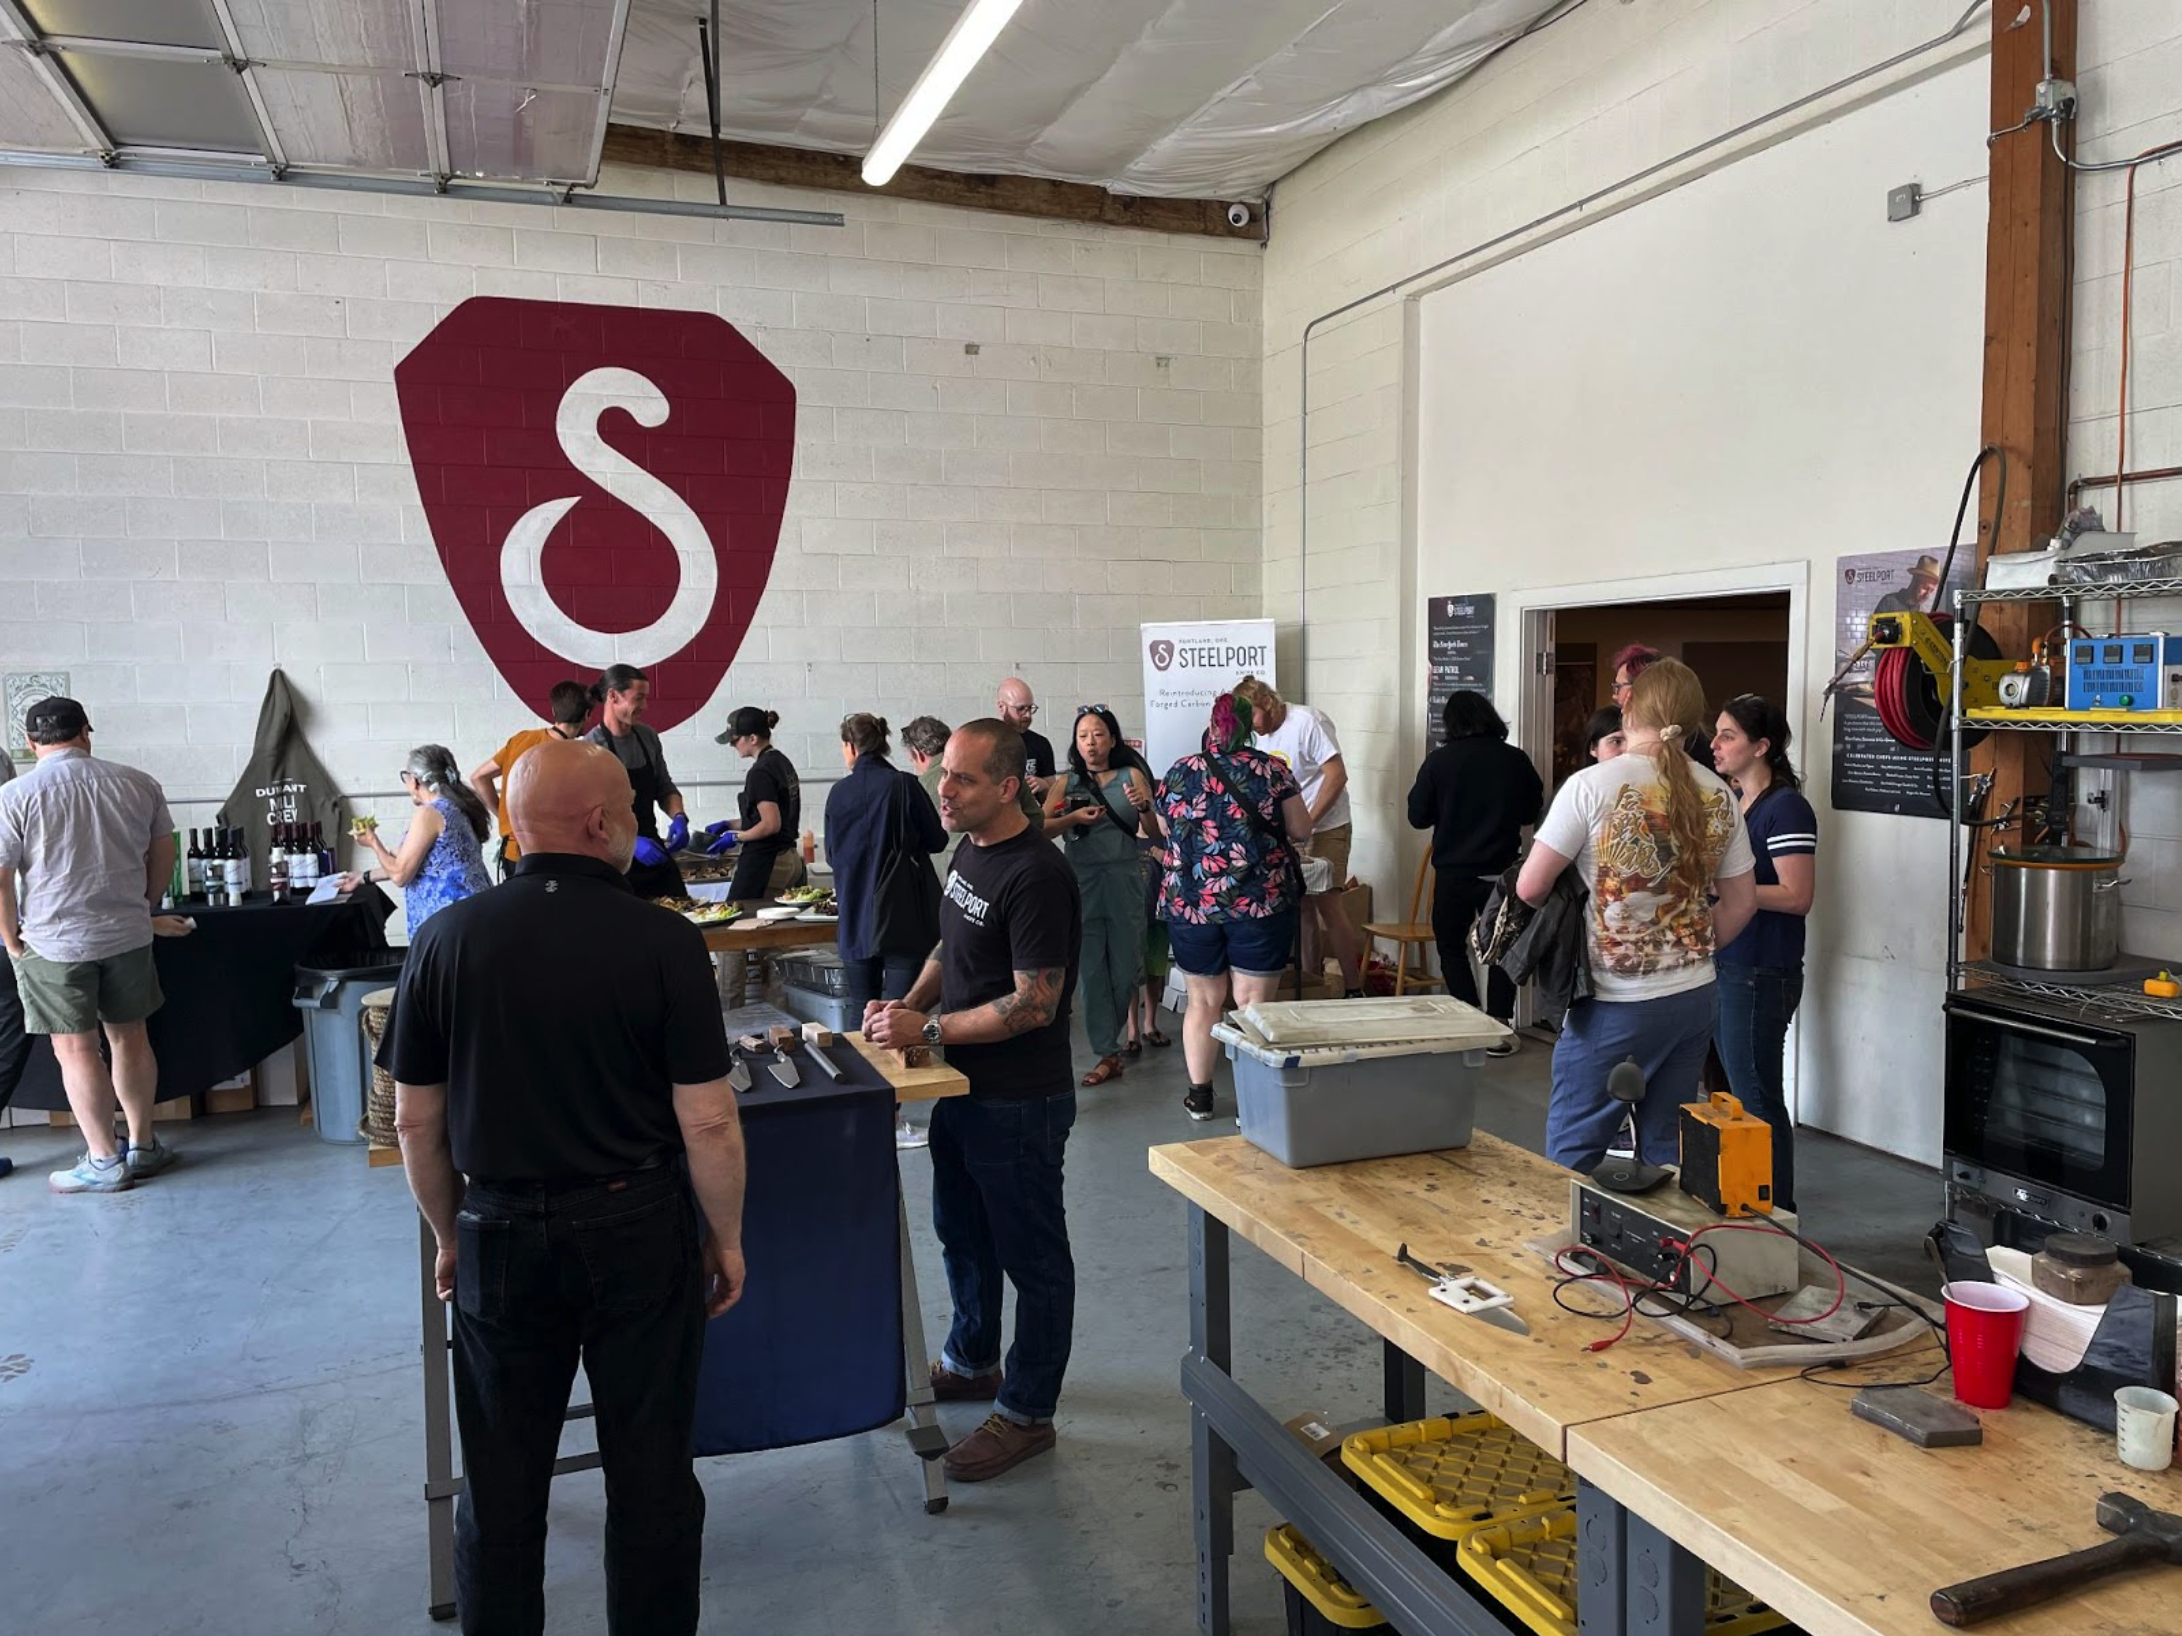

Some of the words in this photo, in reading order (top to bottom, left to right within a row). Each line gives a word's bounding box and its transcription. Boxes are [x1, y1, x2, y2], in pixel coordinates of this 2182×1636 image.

[1856, 569, 1895, 583] STEELPORT
[1179, 646, 1267, 668] STEELPORT
[1159, 689, 1217, 698] Reintroducing
[1150, 700, 1178, 710] Forged
[1181, 700, 1210, 708] Carbon
[950, 882, 990, 920] STEELPORT
